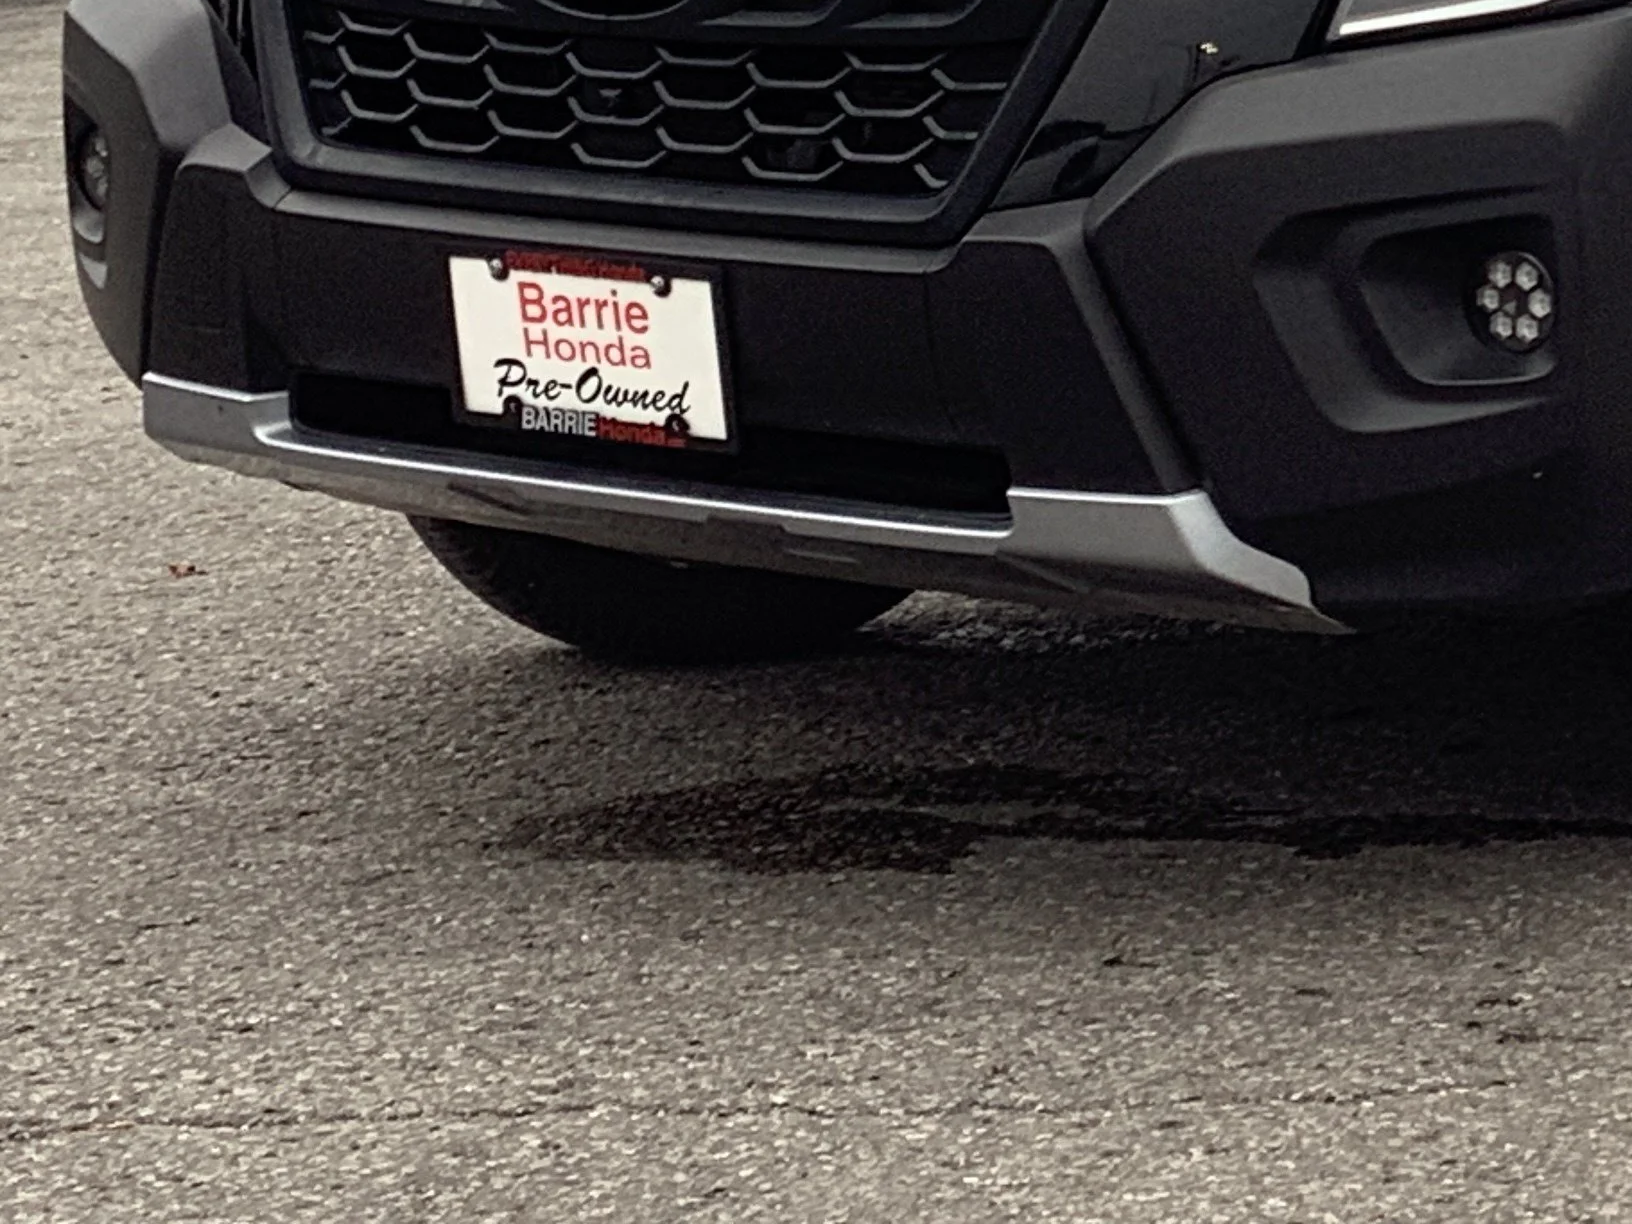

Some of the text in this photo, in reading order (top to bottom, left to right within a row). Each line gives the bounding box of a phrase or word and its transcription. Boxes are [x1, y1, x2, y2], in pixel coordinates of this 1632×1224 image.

[516, 281, 649, 334] Barrie
[522, 327, 652, 370] Honda
[493, 357, 691, 416] Pre-Owned
[521, 405, 598, 438] BARRIE
